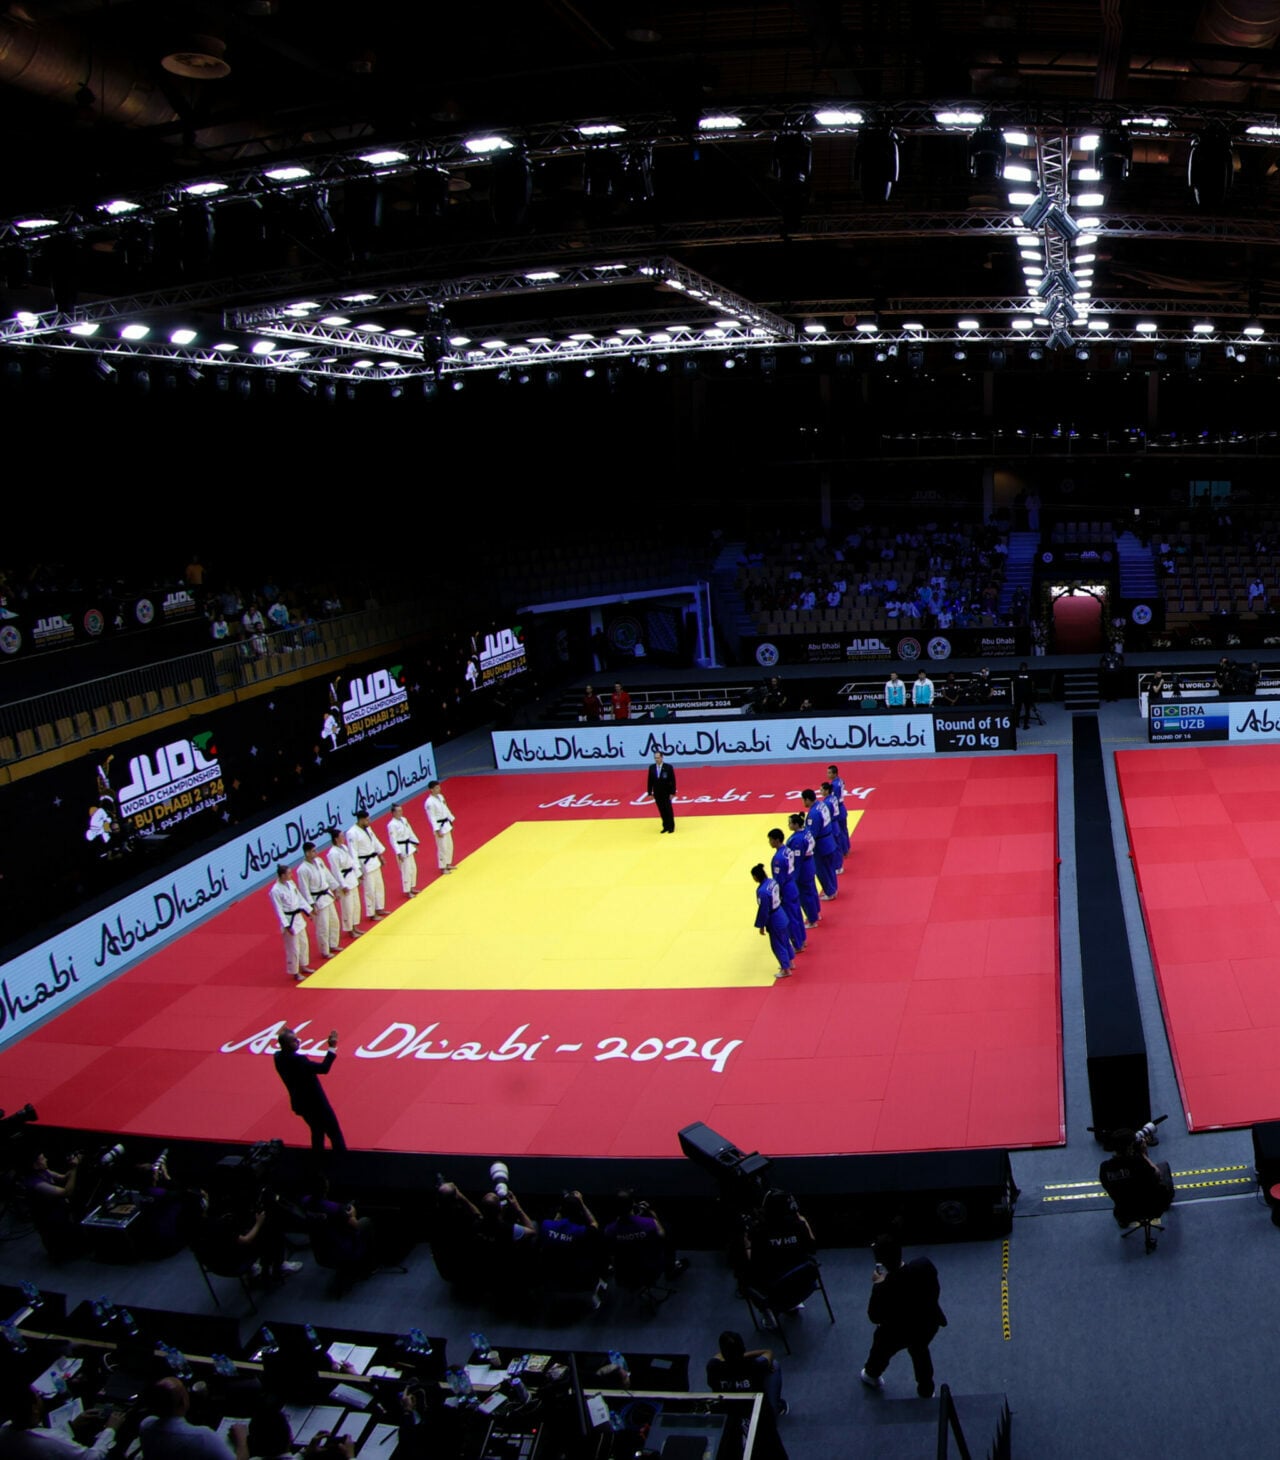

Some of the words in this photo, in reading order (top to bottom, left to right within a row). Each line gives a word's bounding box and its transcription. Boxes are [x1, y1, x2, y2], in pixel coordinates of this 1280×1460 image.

[1185, 681, 1209, 689] WORLD
[1153, 707, 1161, 716] 0
[1180, 706, 1204, 716] BRA
[346, 723, 364, 736] ABU
[365, 710, 389, 729] DHABI
[935, 717, 975, 731] Round
[978, 716, 991, 729] of
[994, 716, 1010, 729] 16
[1153, 721, 1160, 729] 0
[1180, 719, 1205, 729] UZB
[949, 733, 977, 747] -70
[980, 733, 999, 748] kg
[122, 794, 156, 815] WORLD
[156, 766, 220, 802] CHAMPIONSHIPS
[539, 795, 619, 808] Abu
[129, 812, 155, 830] BU
[155, 795, 194, 820] DHABI
[355, 1021, 550, 1061] Dhabi
[595, 1037, 743, 1073] 2024
[549, 1230, 560, 1240] TV
[560, 1233, 573, 1242] RH
[770, 1238, 782, 1246] TV
[784, 1236, 798, 1245] HB
[735, 1379, 750, 1389] HB
